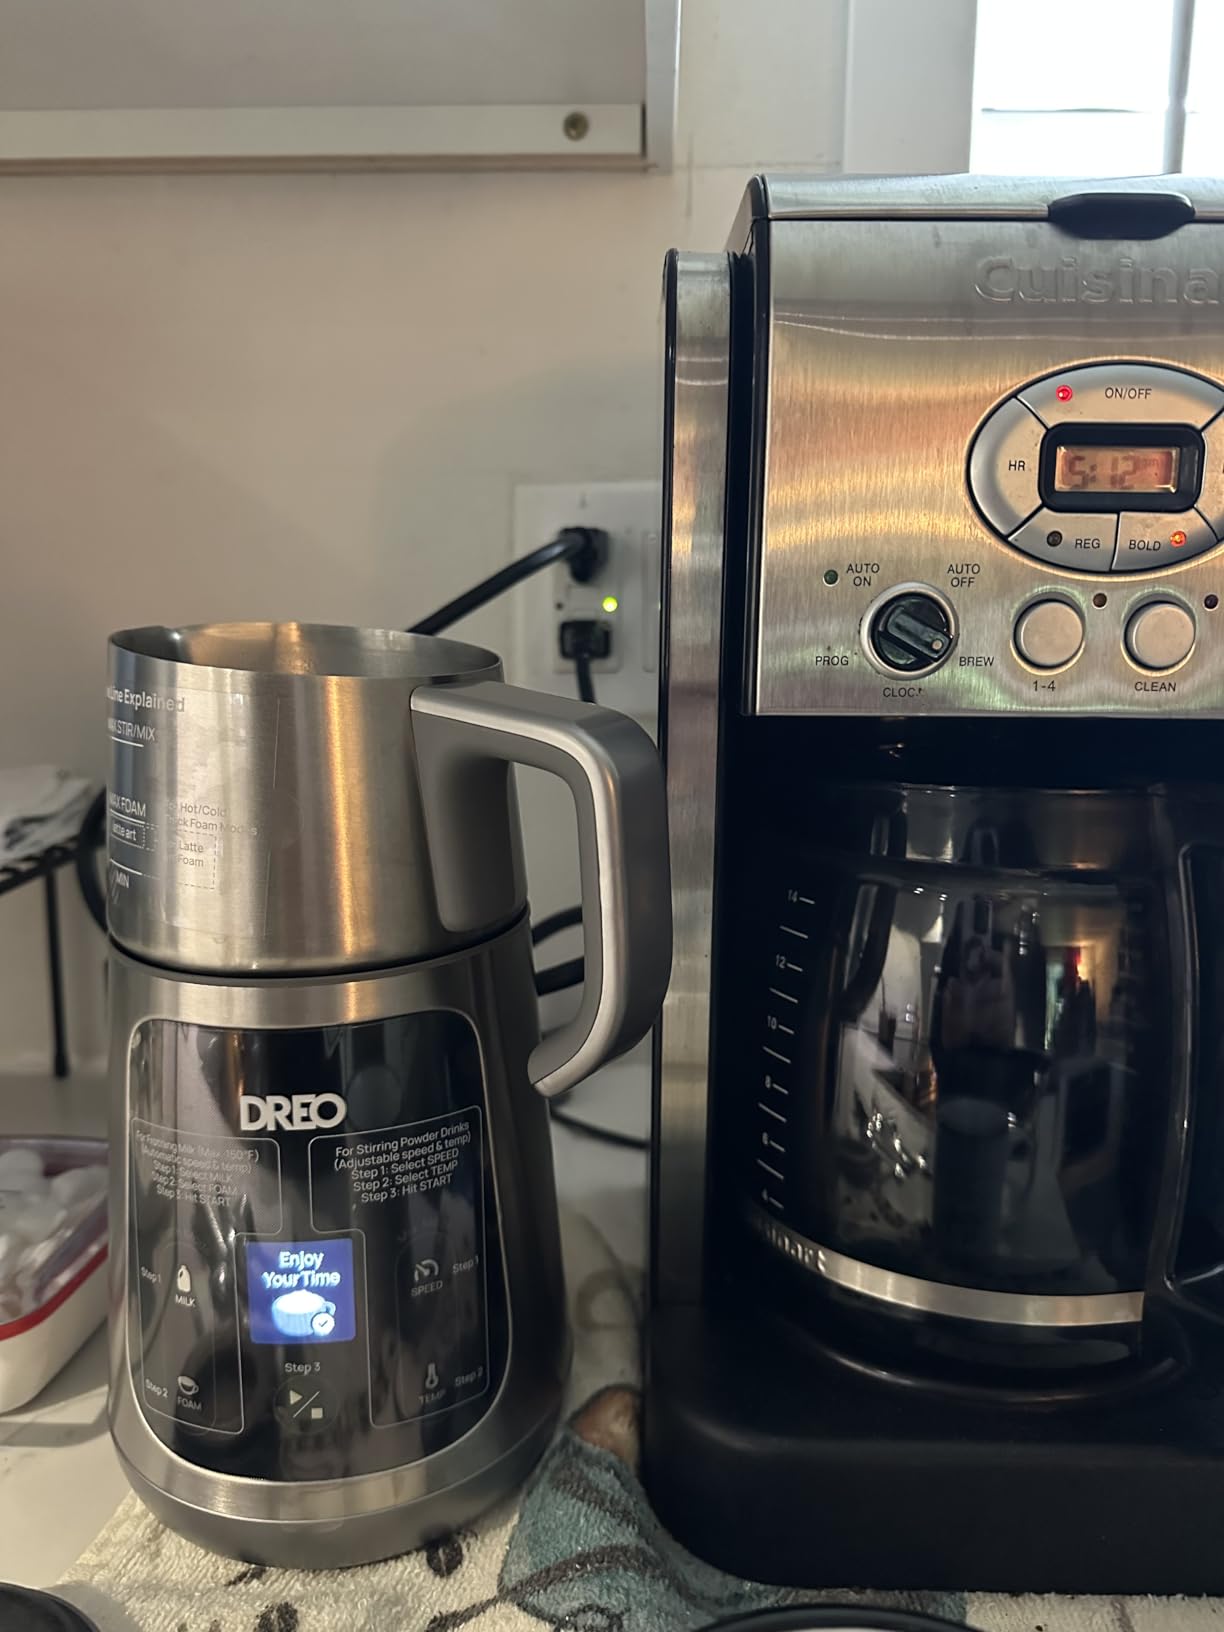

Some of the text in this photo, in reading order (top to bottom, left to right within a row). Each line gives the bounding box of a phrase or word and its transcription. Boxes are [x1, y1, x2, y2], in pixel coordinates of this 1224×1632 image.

[1104, 387, 1152, 400] ON/OFF
[1008, 460, 1026, 472] HR
[1075, 538, 1101, 550] REG
[1128, 540, 1161, 552] BOLD
[846, 563, 880, 575] AUTO
[947, 563, 981, 575] AUTO
[852, 575, 872, 588] ON
[951, 576, 976, 589] OFF
[815, 655, 849, 668] PROG
[959, 656, 995, 668] BREW
[1033, 681, 1056, 692] 1-4
[1134, 681, 1177, 693] CLEAN
[124, 688, 185, 712] Explained
[117, 719, 156, 741] STIR/MIX
[120, 796, 147, 817] FOAM
[190, 818, 218, 831] Foam
[179, 840, 204, 853] Latte
[177, 853, 204, 867] Foam
[776, 954, 786, 969] 12
[767, 1015, 777, 1030] 10
[240, 1092, 347, 1131] DREO
[335, 1121, 470, 1158] For Stirring Powder Drinks
[334, 1131, 472, 1171] (Adjustable speed & temp)
[351, 1149, 460, 1181] Step 1: Select SPEED
[353, 1160, 459, 1192] Step 2: Select TEMP
[361, 1173, 453, 1203] Step 3: Hit START
[278, 1251, 325, 1270] Enjoy
[262, 1270, 341, 1288] Your Time
[411, 1280, 443, 1297] SPEED
[175, 1294, 196, 1307] MILK
[284, 1362, 321, 1376] Step 3
[177, 1397, 201, 1411] FOAM
